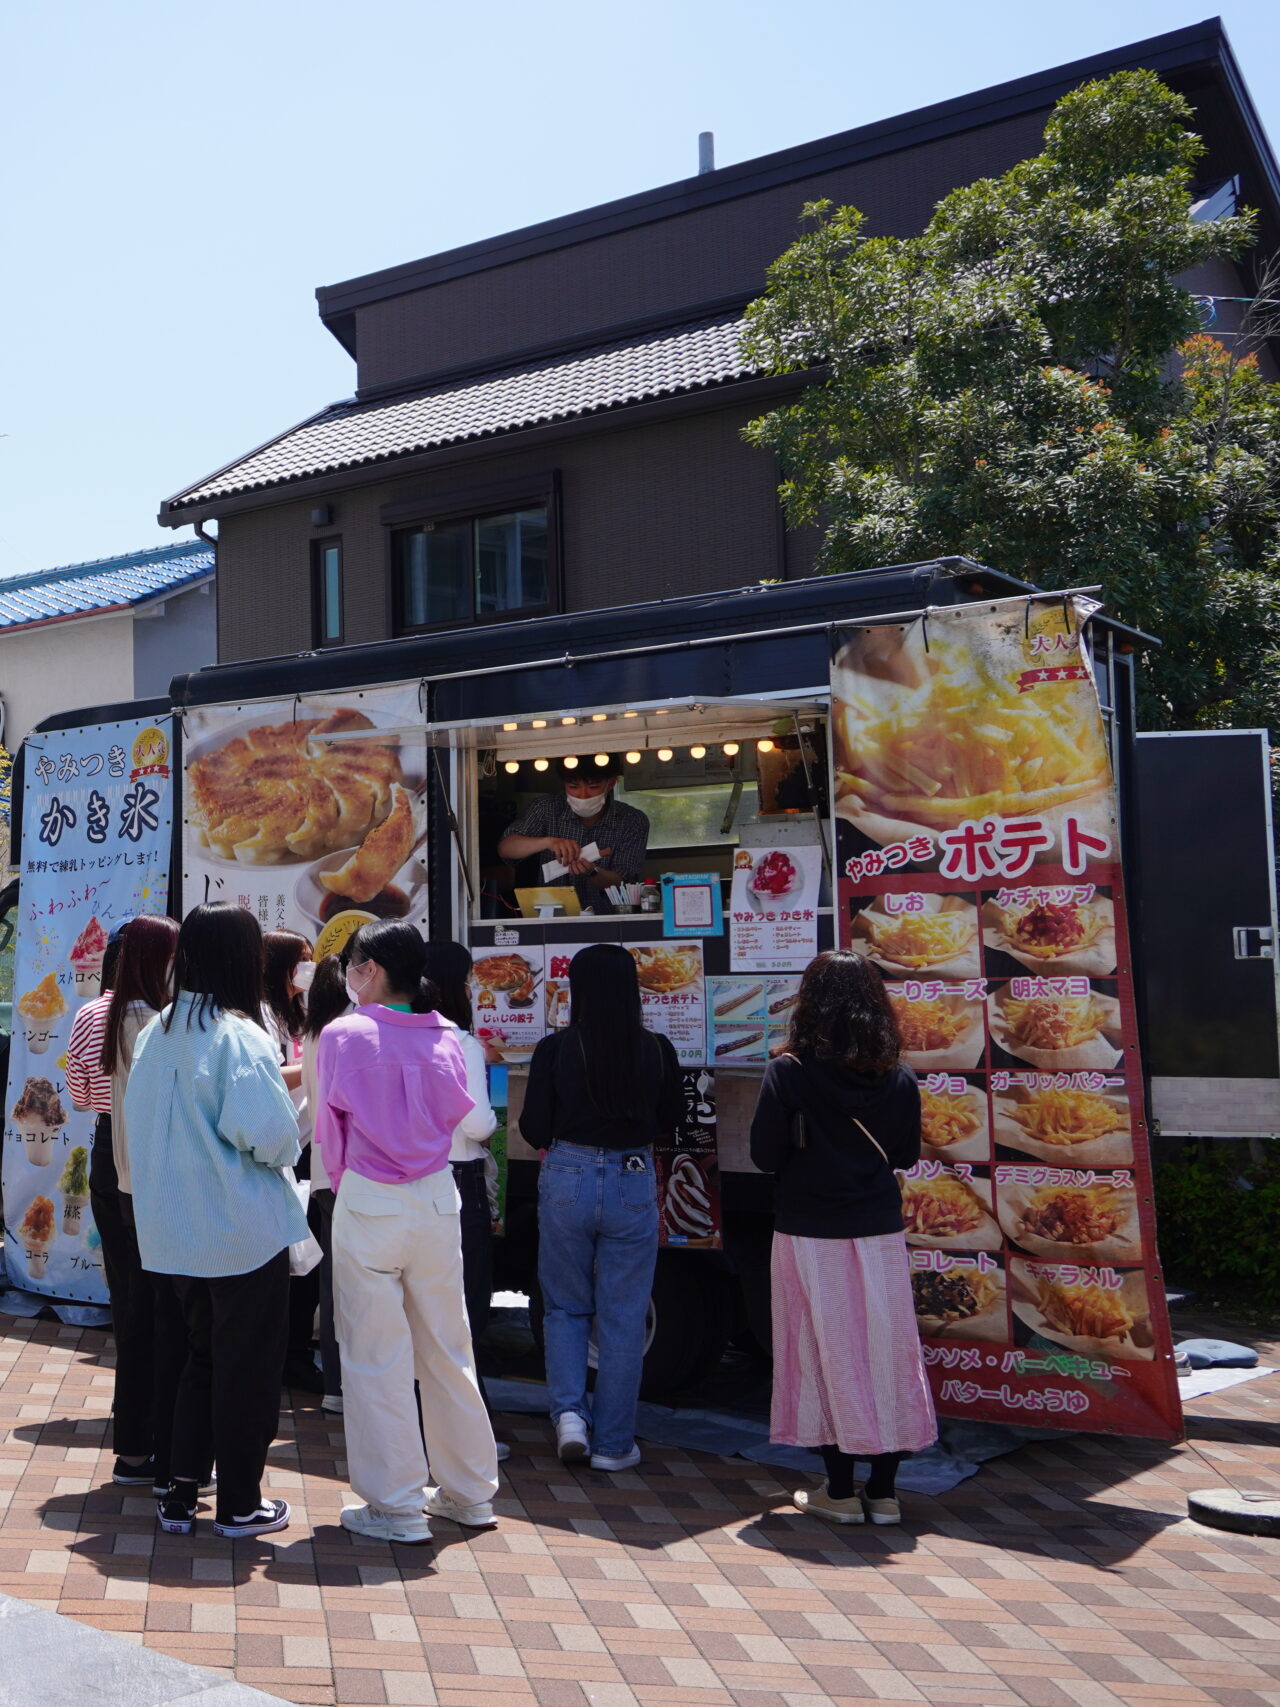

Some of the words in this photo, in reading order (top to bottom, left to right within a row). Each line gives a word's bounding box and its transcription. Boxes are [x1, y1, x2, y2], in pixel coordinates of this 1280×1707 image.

[35, 745, 127, 786] やみつき
[39, 782, 160, 847] かき氷
[846, 835, 935, 882] やみつき
[941, 814, 1111, 880] ポテト
[884, 892, 926, 914] しお
[995, 884, 1097, 908] ケチャップ
[733, 912, 777, 922] やみつき
[780, 909, 814, 921] かき氷
[1011, 976, 1091, 1000] 明太マヨ
[482, 1013, 536, 1025] じぃじの餃子
[991, 1073, 1125, 1091] ガーリックバター
[894, 1161, 975, 1183] リソース
[995, 1167, 1134, 1188] デミグラスソース
[64, 1203, 81, 1220] 抹茶
[25, 1250, 49, 1264] コーラ
[907, 1250, 998, 1274] コレート
[1024, 1262, 1122, 1289] キャラメル
[941, 1381, 1090, 1414] バターしょうゆ
